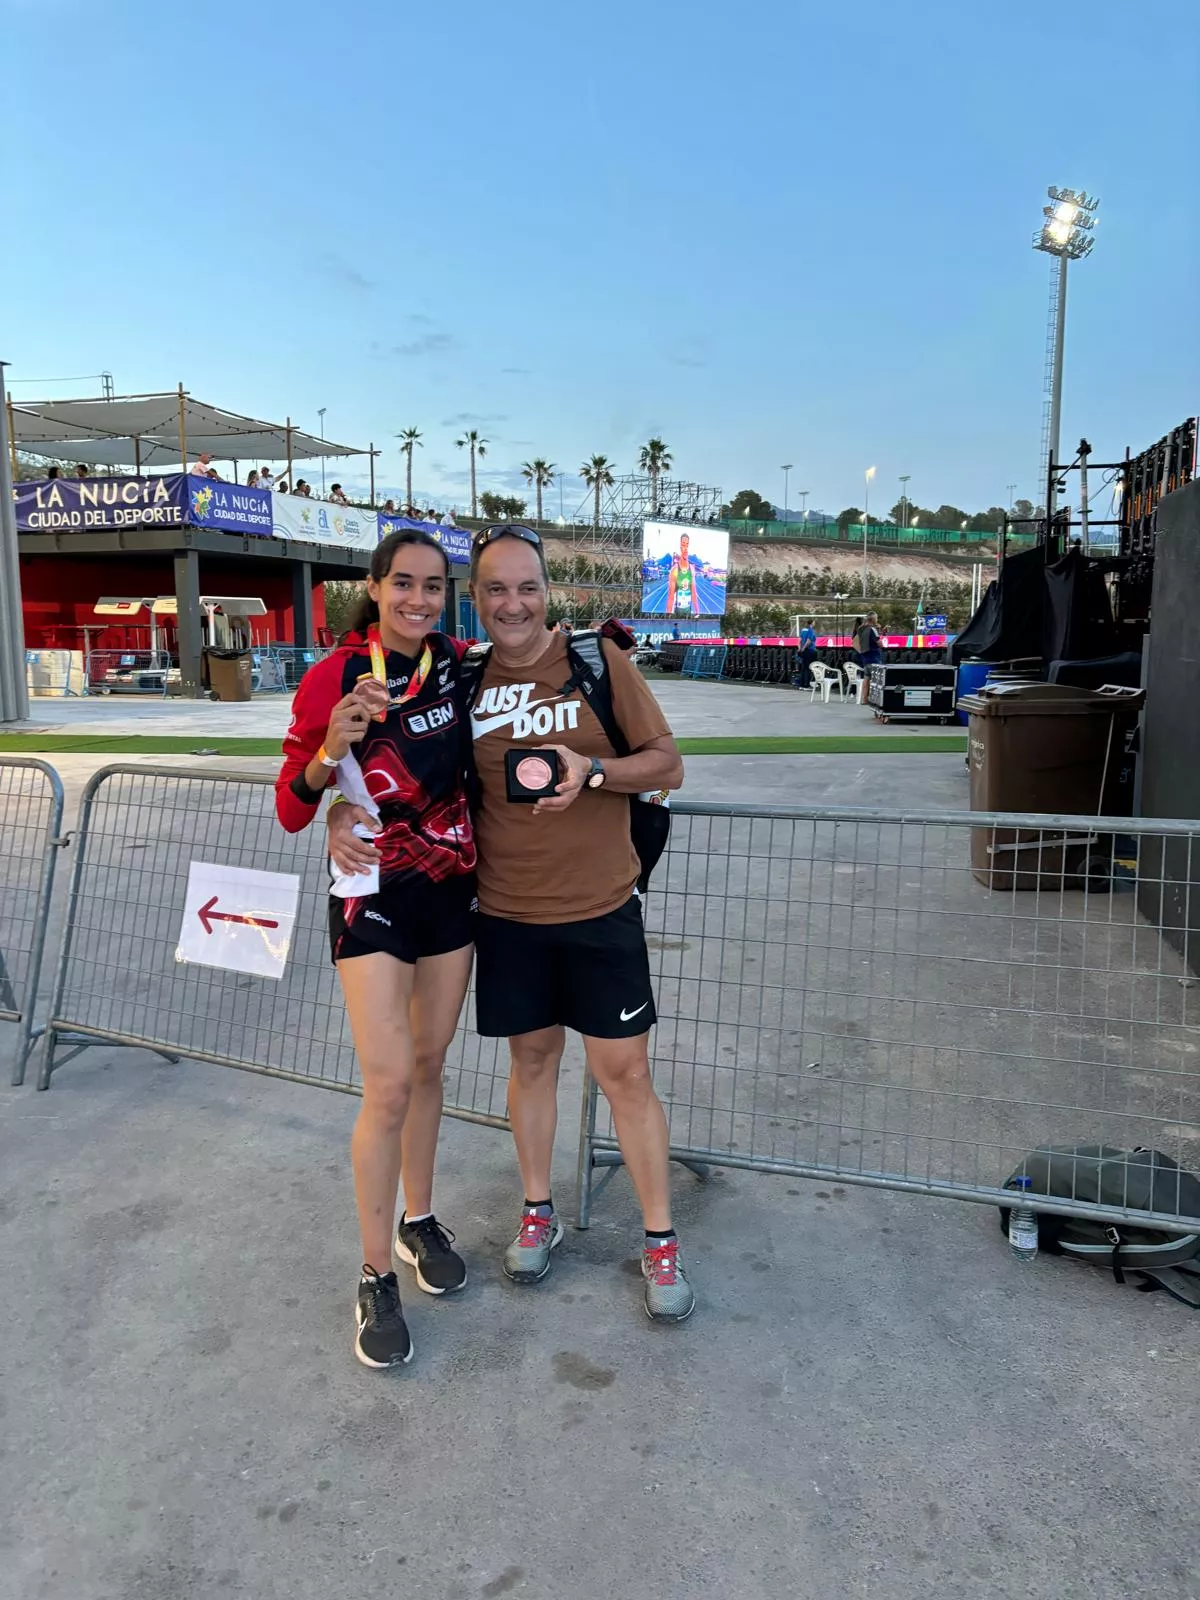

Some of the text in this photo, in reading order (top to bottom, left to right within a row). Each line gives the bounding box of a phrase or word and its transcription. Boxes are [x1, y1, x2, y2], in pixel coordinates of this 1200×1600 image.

[36, 483, 64, 508] LA
[215, 491, 228, 508] LA
[28, 506, 182, 528] CIUDAD DEL DEPORTE
[213, 509, 272, 526] CIUDAD DEL DEPORTE
[386, 675, 409, 689] lbao
[473, 682, 536, 714] JUST
[512, 700, 581, 739] DO IT
